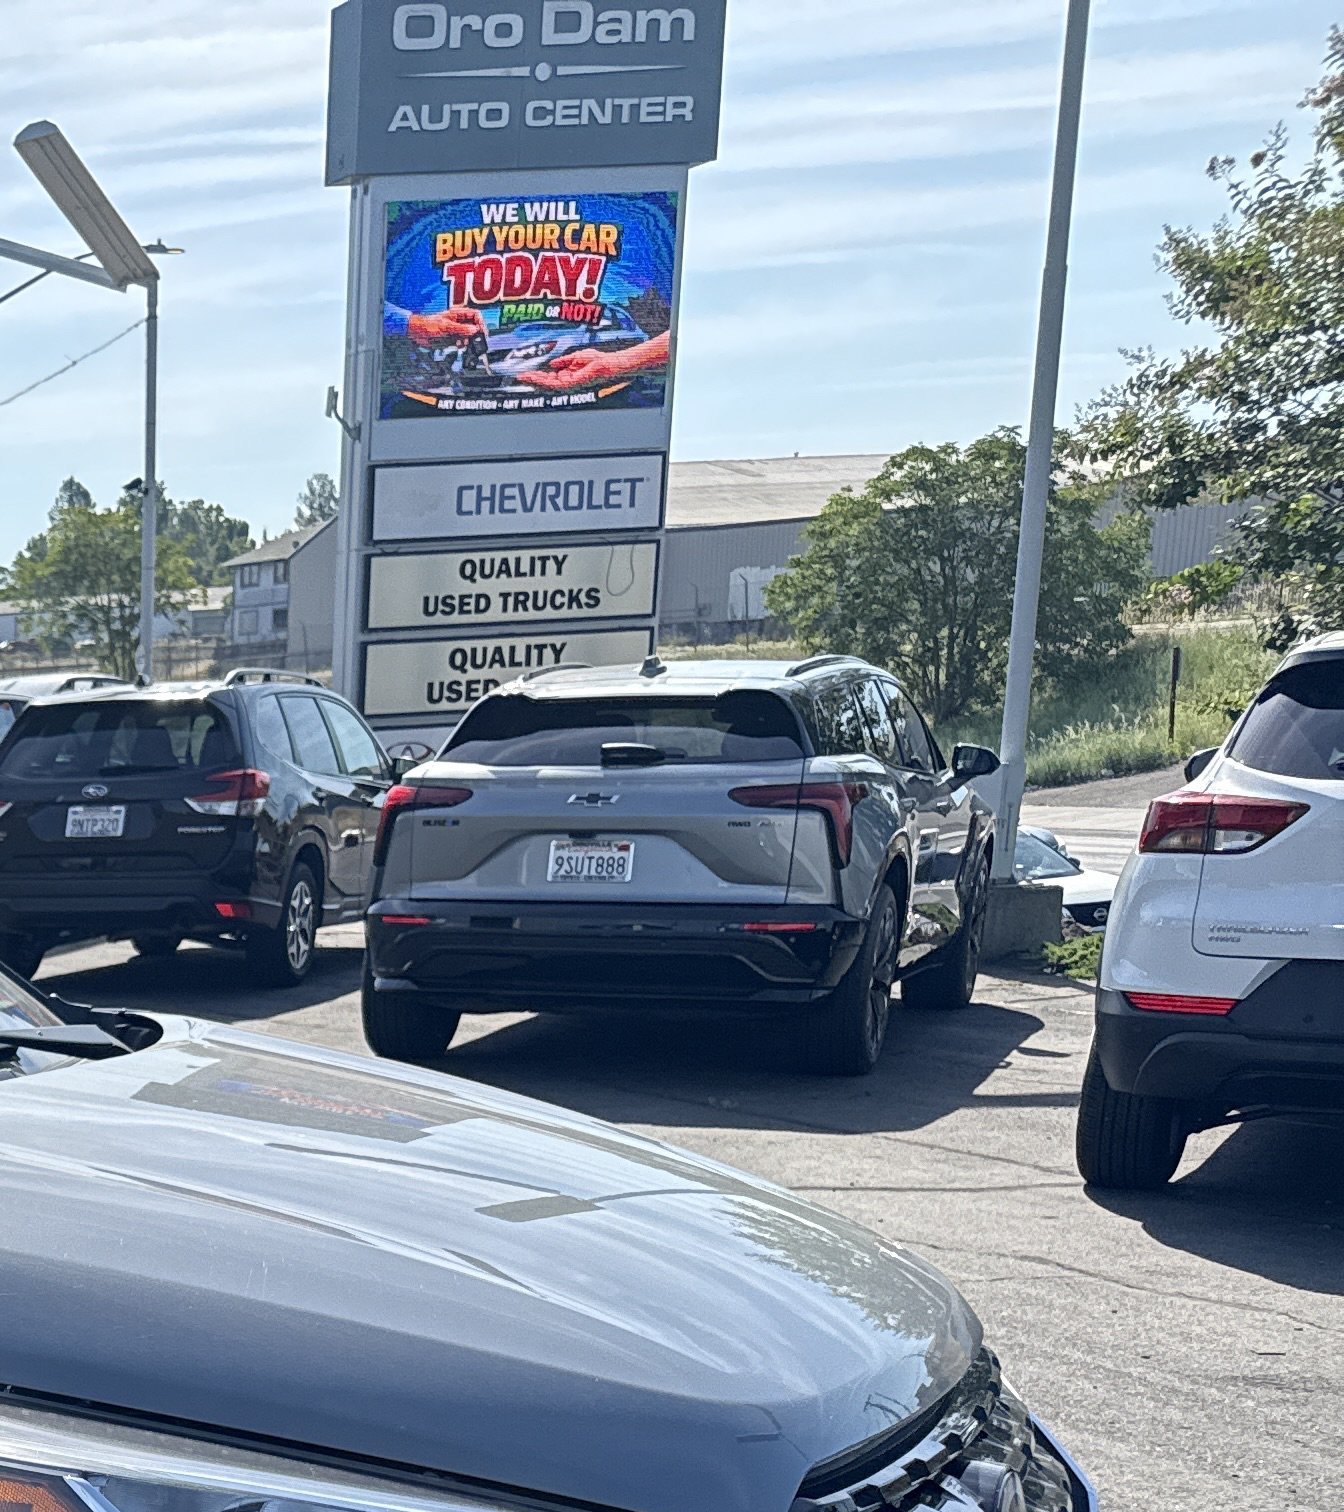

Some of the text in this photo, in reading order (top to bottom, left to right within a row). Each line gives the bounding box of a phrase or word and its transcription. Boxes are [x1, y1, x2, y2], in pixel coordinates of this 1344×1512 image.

[392, 0, 696, 51] Oro Dam
[387, 95, 694, 132] AUTO CENTER
[480, 200, 580, 224] WE WILL
[435, 223, 619, 263] BUY YOUR CAR
[443, 251, 607, 307] TODAY!
[501, 303, 545, 323] PAID
[560, 304, 602, 325] NOT!
[455, 477, 645, 517] CHEVROLET
[459, 554, 569, 583] QUALITY
[422, 587, 602, 618] USED TRUCKS
[448, 642, 568, 674] QUALITY
[553, 855, 627, 876] 9SUT888
